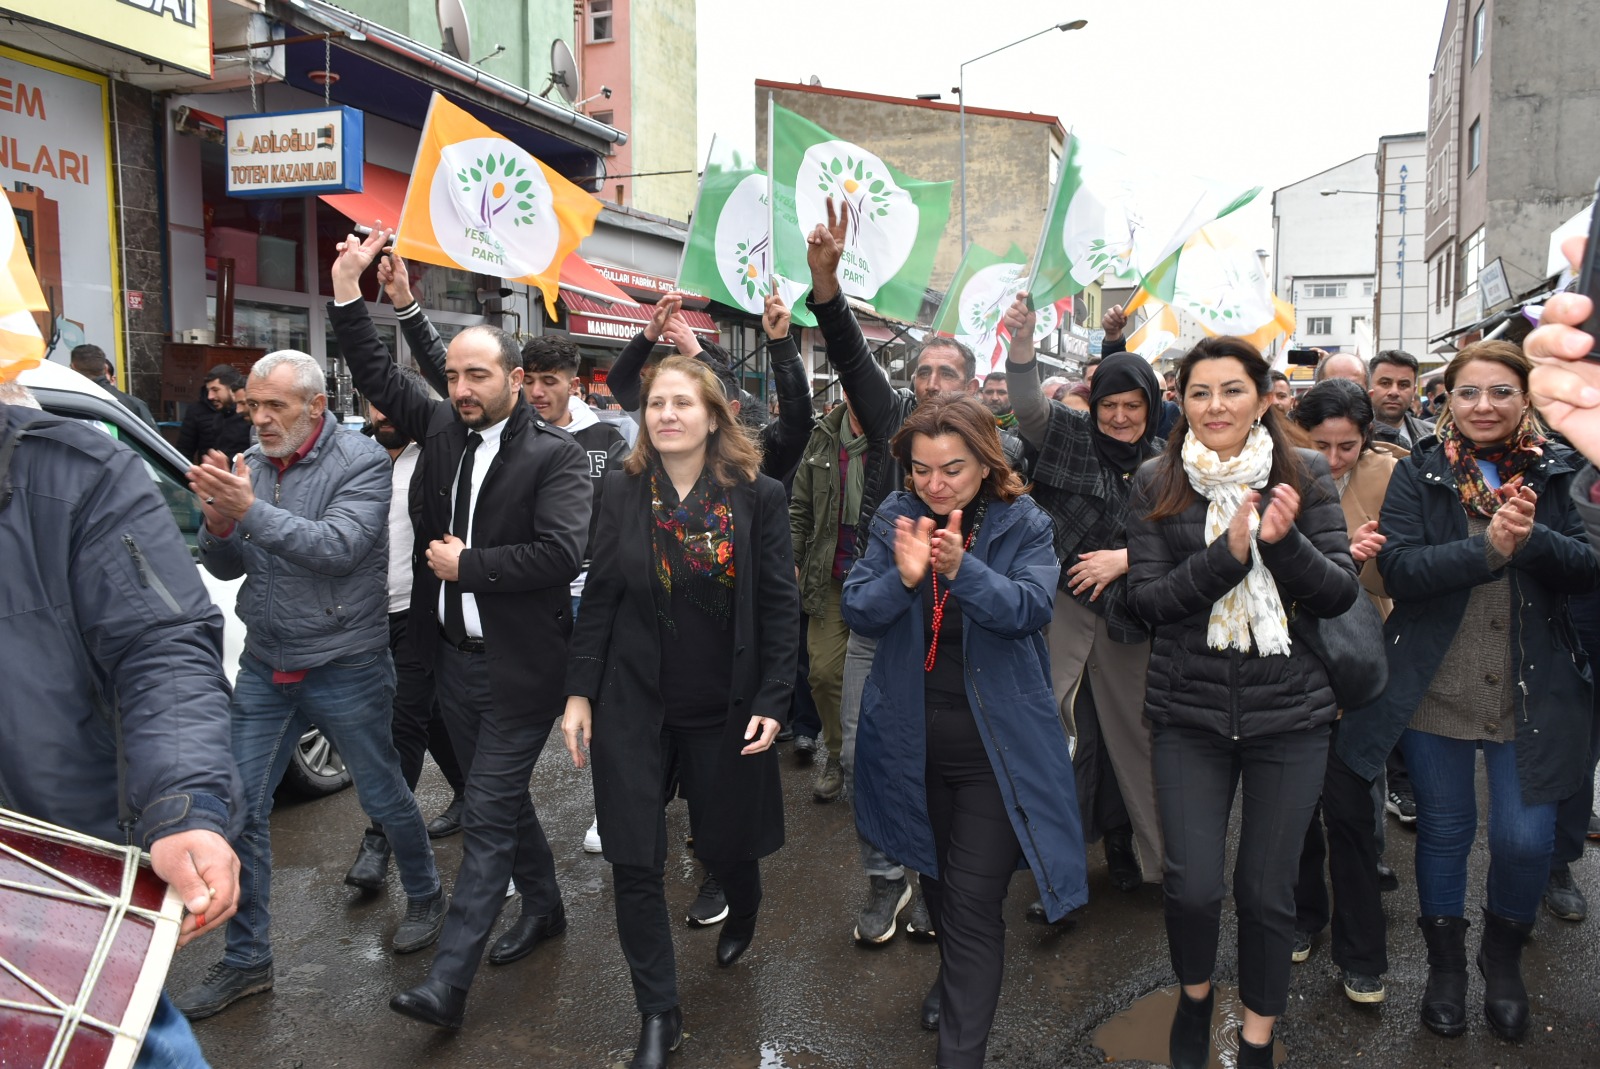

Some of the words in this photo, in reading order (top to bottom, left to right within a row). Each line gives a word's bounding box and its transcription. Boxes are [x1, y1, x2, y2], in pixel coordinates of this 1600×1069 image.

[251, 128, 316, 154] ADİLOĞLU
[231, 165, 269, 184] TOTEM
[271, 161, 337, 183] KAZANLARI
[841, 250, 857, 266] EŞİL
[858, 257, 870, 273] SOL
[595, 267, 630, 284] OĞULLARI
[631, 275, 657, 289] FABRİKA
[843, 268, 865, 287] PARTİ
[586, 450, 608, 477] F
